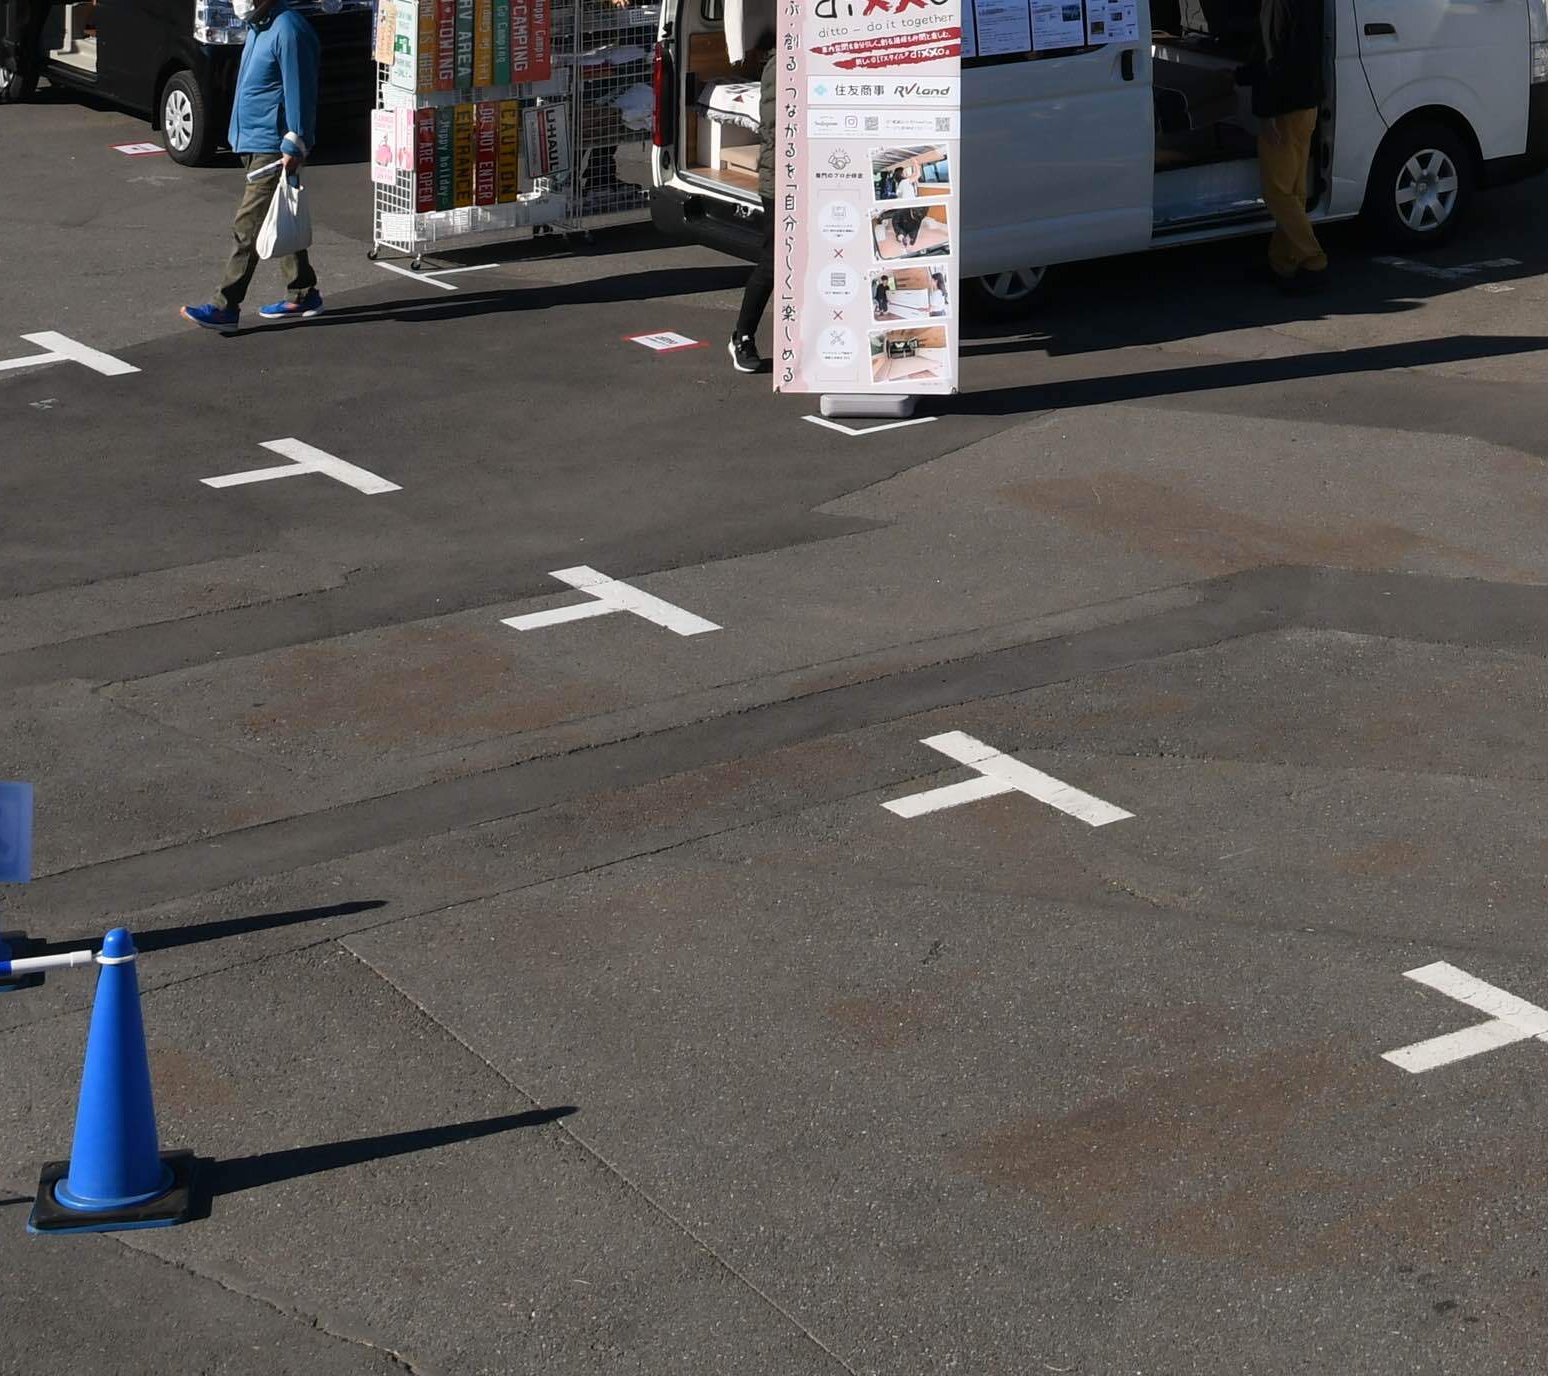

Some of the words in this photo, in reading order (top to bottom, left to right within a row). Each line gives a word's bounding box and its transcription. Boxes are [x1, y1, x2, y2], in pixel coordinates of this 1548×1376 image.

[513, 3, 529, 73] CAMPING
[818, 26, 848, 39] ditto
[866, 21, 882, 33] do
[886, 20, 896, 30] it
[901, 14, 954, 29] together
[458, 31, 473, 78] AREA
[532, 29, 547, 64] Camper
[835, 84, 885, 97] 住友商事
[419, 141, 435, 165] ARE
[456, 111, 471, 201] ENTRANCE
[479, 129, 494, 153] NOT
[501, 108, 517, 199] CAUTION
[546, 109, 559, 169] U-HAUL
[419, 171, 435, 204] OPEN
[479, 161, 494, 203] ENTER
